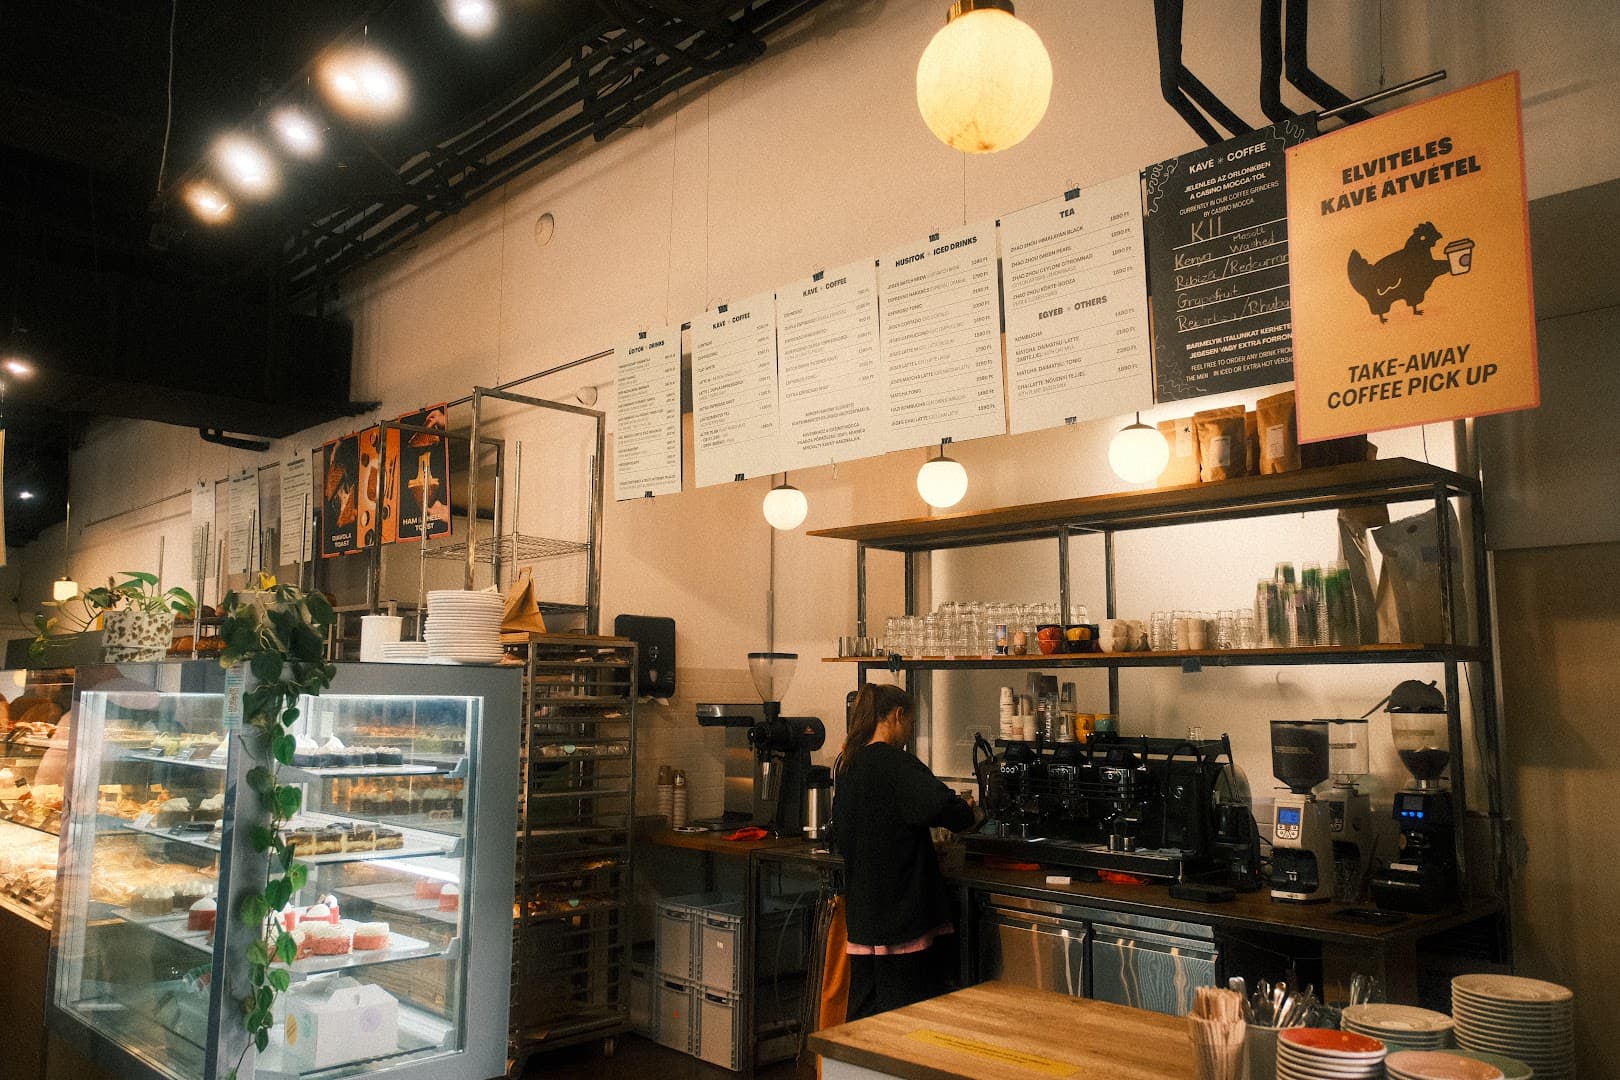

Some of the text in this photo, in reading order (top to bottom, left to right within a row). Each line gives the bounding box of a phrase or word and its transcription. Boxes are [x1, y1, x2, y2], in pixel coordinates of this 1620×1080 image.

[1227, 142, 1267, 162] COFFEE
[1342, 137, 1453, 185] ELVITELES
[1217, 174, 1227, 184] AZ
[1179, 202, 1209, 216] CURRENTLY
[1215, 196, 1228, 205] OUR
[1228, 190, 1249, 201] COFFEE
[1250, 180, 1280, 194] GRINDERS
[1190, 193, 1195, 201] A
[1196, 185, 1222, 198] CASINO
[1059, 208, 1076, 219] TEA
[1203, 197, 1255, 218] BY CASINO MOCCA
[933, 244, 949, 256] ICED
[950, 236, 977, 249] DRINKS
[1174, 252, 1212, 269] Kenya
[825, 277, 847, 290] COFFEE
[1074, 295, 1108, 311] OTHERS
[1177, 284, 1239, 309] Grapefruit
[732, 312, 751, 324] COFFEE
[1219, 344, 1237, 353] VAGY
[1238, 340, 1261, 350] EXTRA
[1186, 374, 1196, 382] THE
[1220, 367, 1233, 376] ICED
[1233, 365, 1242, 373] OR
[1243, 361, 1261, 372] EXTRA
[1262, 359, 1274, 368] HOT
[1191, 363, 1204, 372] FEEL
[1204, 361, 1217, 369] FREE
[1226, 355, 1246, 365] ORDER
[1247, 352, 1258, 360] ANY
[1348, 344, 1471, 383] TAKE-AWAY
[1328, 363, 1498, 409] COFFEE PICK UP
[402, 517, 418, 526] HAM
[334, 540, 350, 549] TOAST
